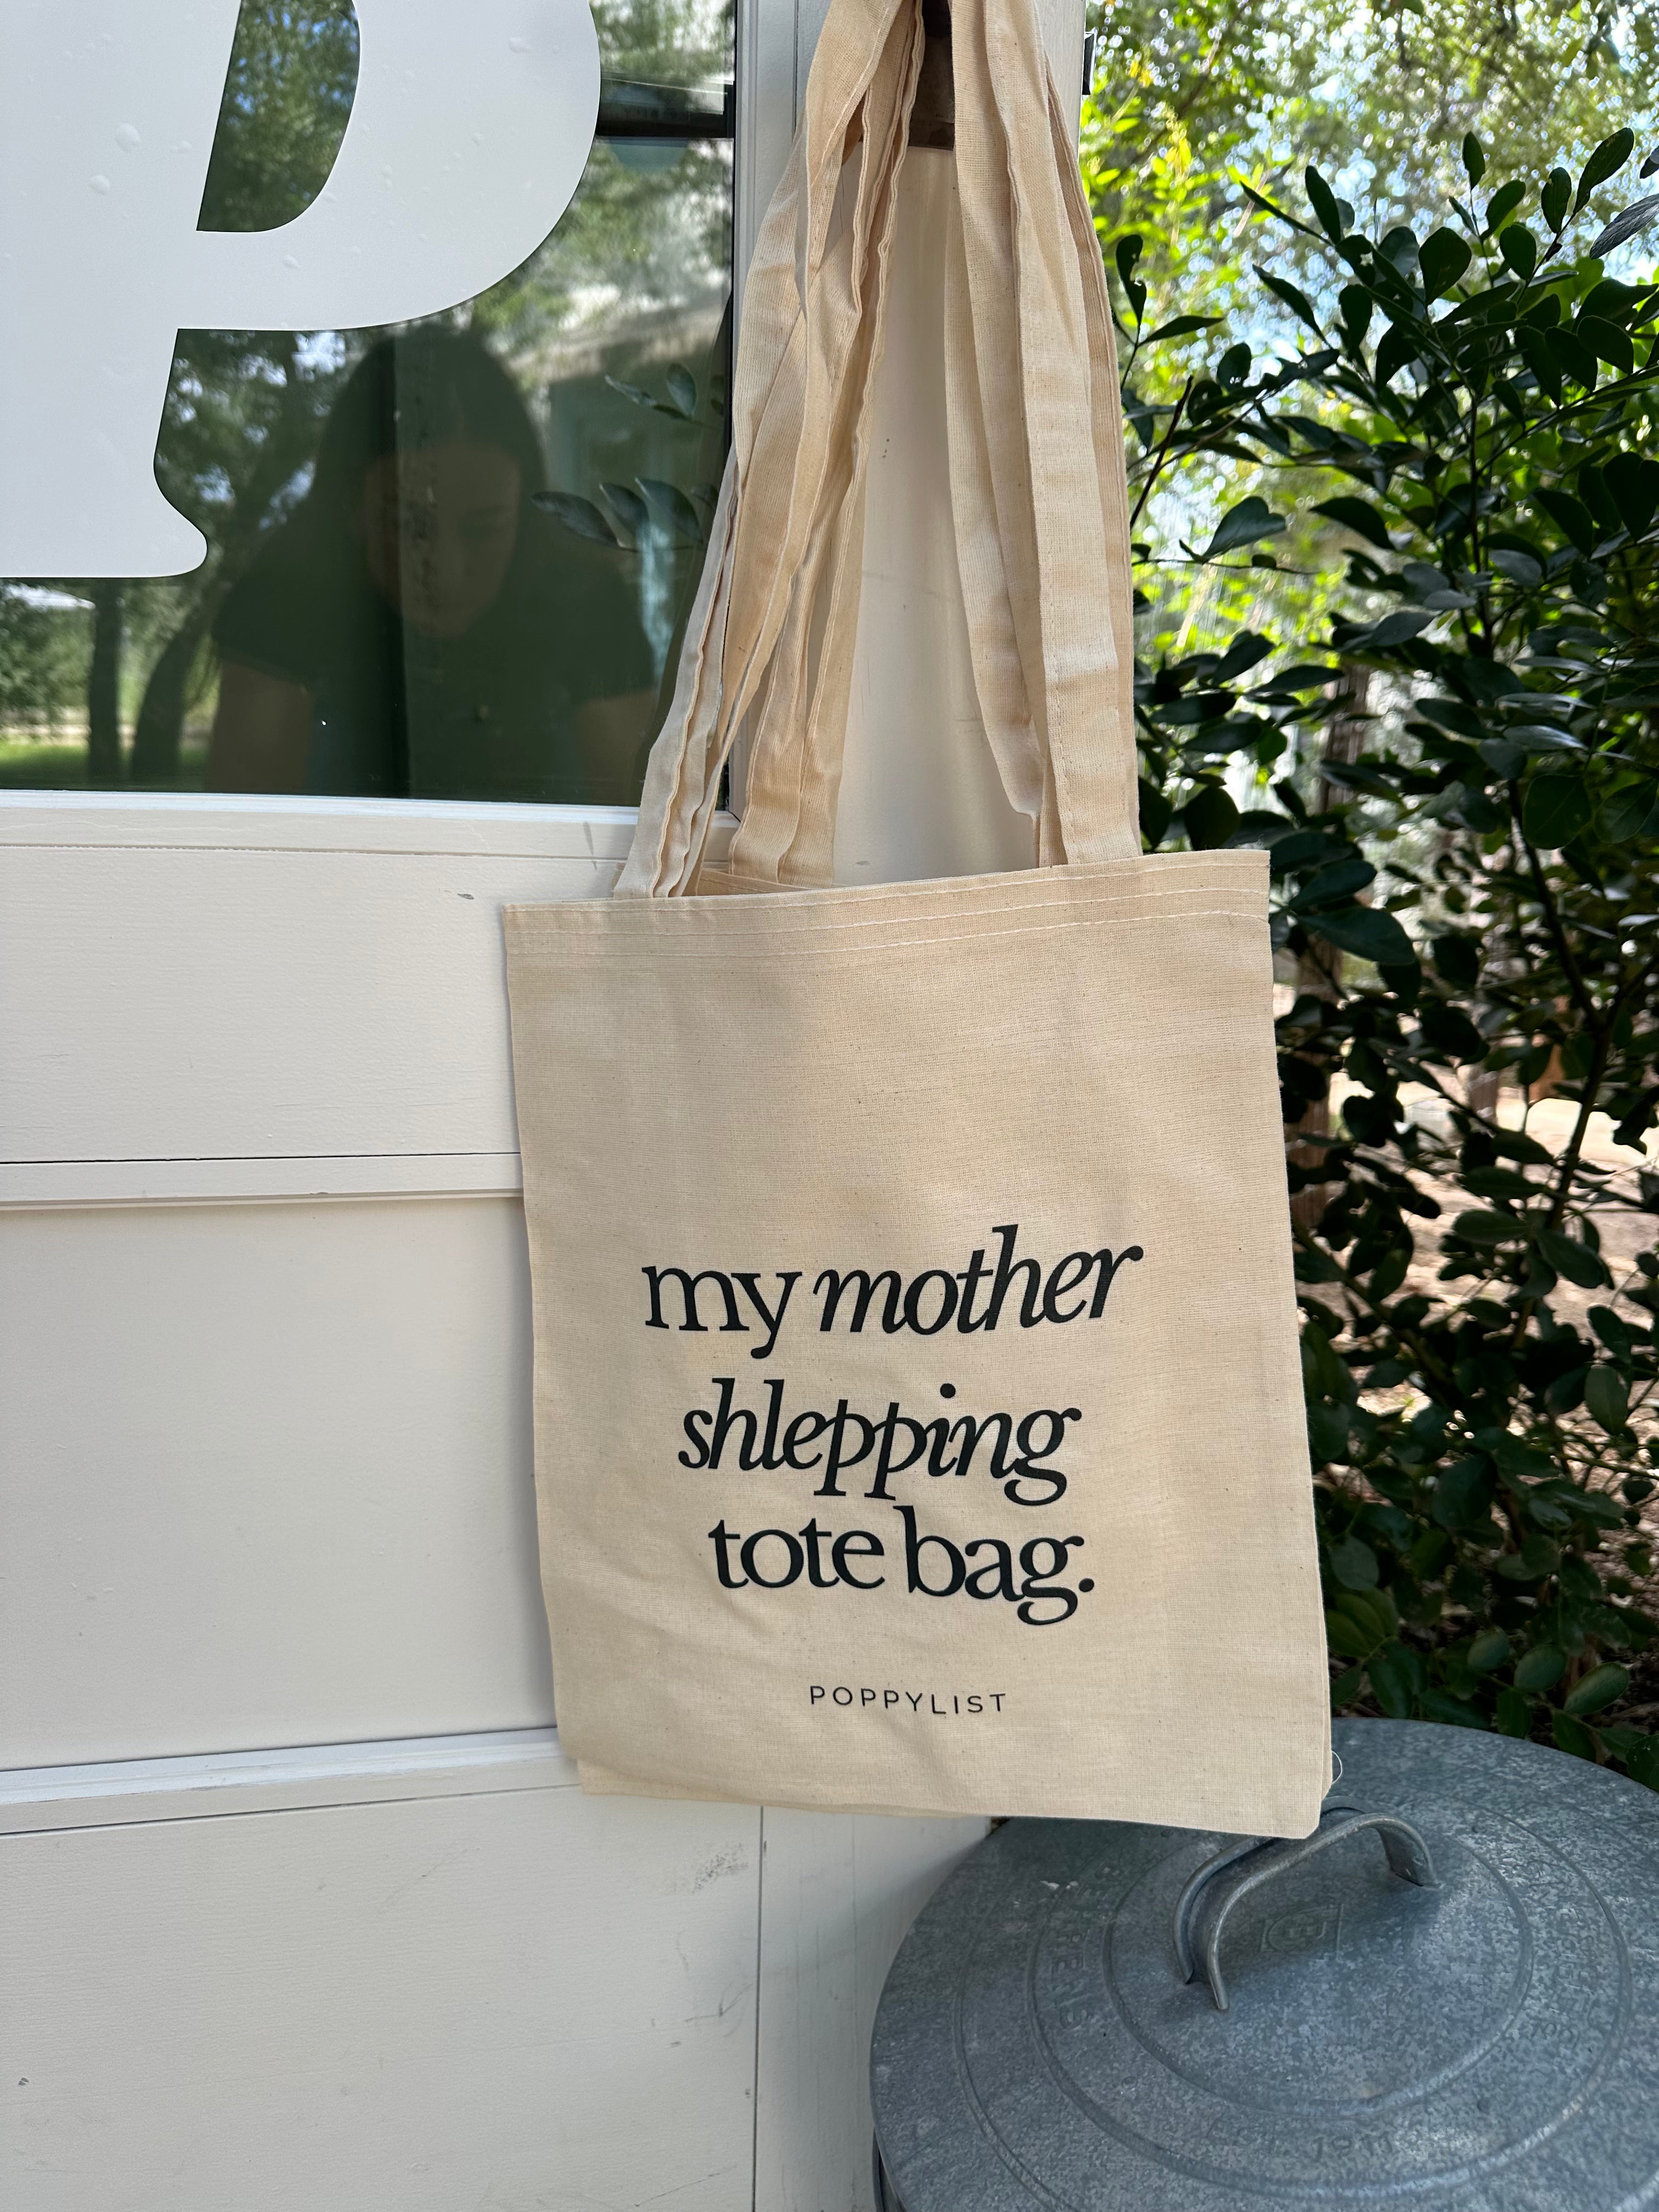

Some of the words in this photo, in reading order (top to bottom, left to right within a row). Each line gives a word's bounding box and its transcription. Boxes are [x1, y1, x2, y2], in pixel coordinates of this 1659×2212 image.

[642, 1265, 803, 1359] my
[812, 1223, 1144, 1335] mother
[678, 1378, 1082, 1506] shlepping
[708, 1518, 885, 1589] tote
[893, 1505, 1094, 1626] bag.
[810, 1685, 1007, 1715] POPPYLIST
